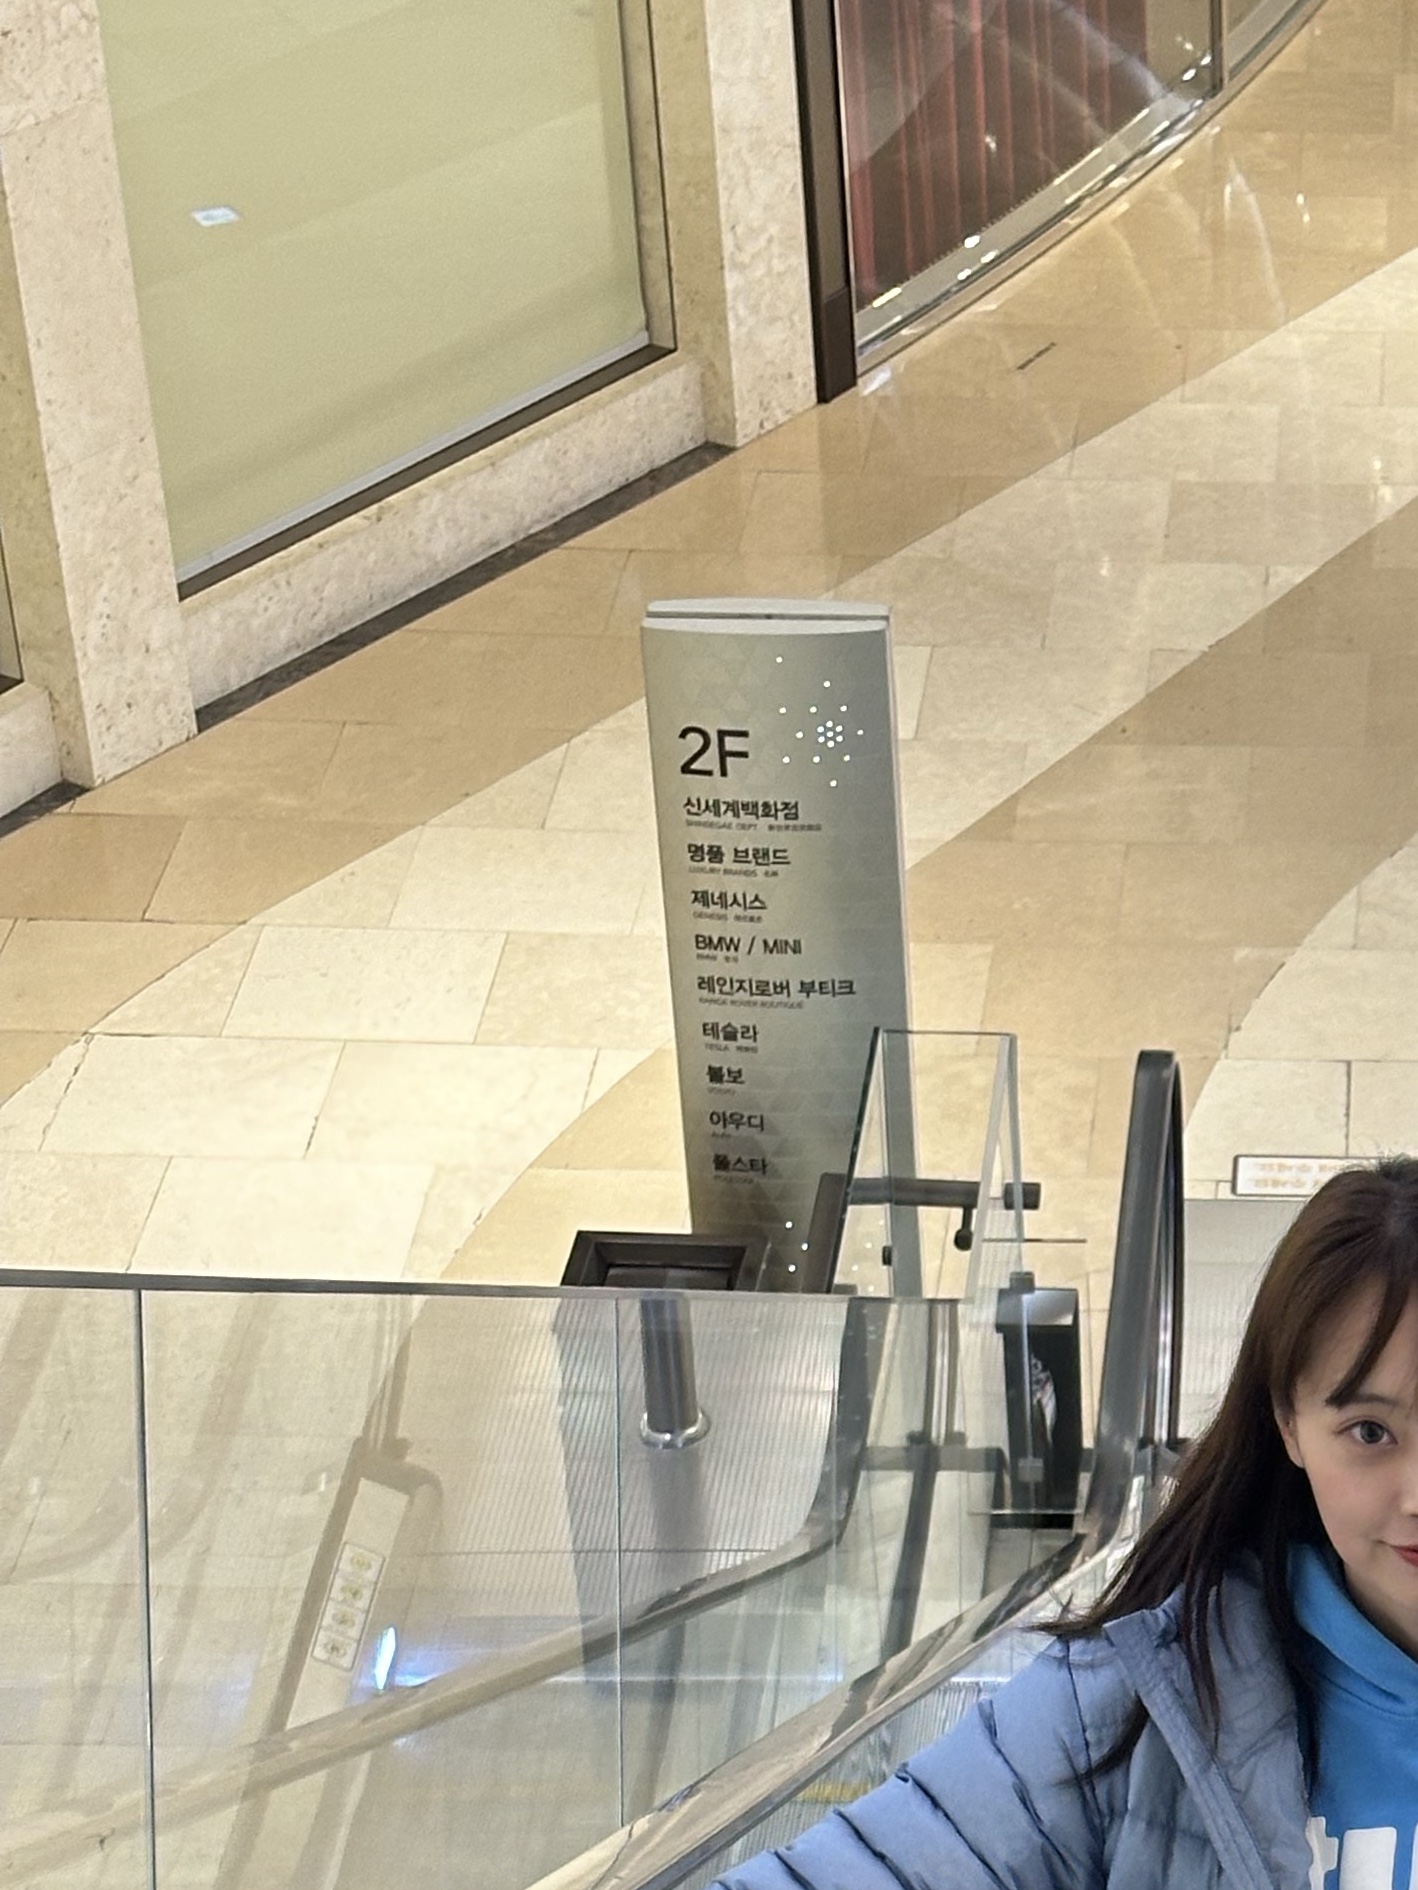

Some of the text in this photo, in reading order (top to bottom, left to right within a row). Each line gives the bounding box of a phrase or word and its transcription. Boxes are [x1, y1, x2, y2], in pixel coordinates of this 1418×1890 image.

[678, 726, 750, 778] 2F
[683, 796, 799, 820] 신세계백화점
[687, 843, 791, 866] 명품 브랜드
[691, 889, 767, 911] 제네시스
[695, 934, 741, 952] BMW
[763, 938, 802, 954] MINI
[697, 975, 856, 998] 레인지로버 부티크
[702, 1022, 759, 1043] 테슬라
[709, 1110, 765, 1133] 아우디
